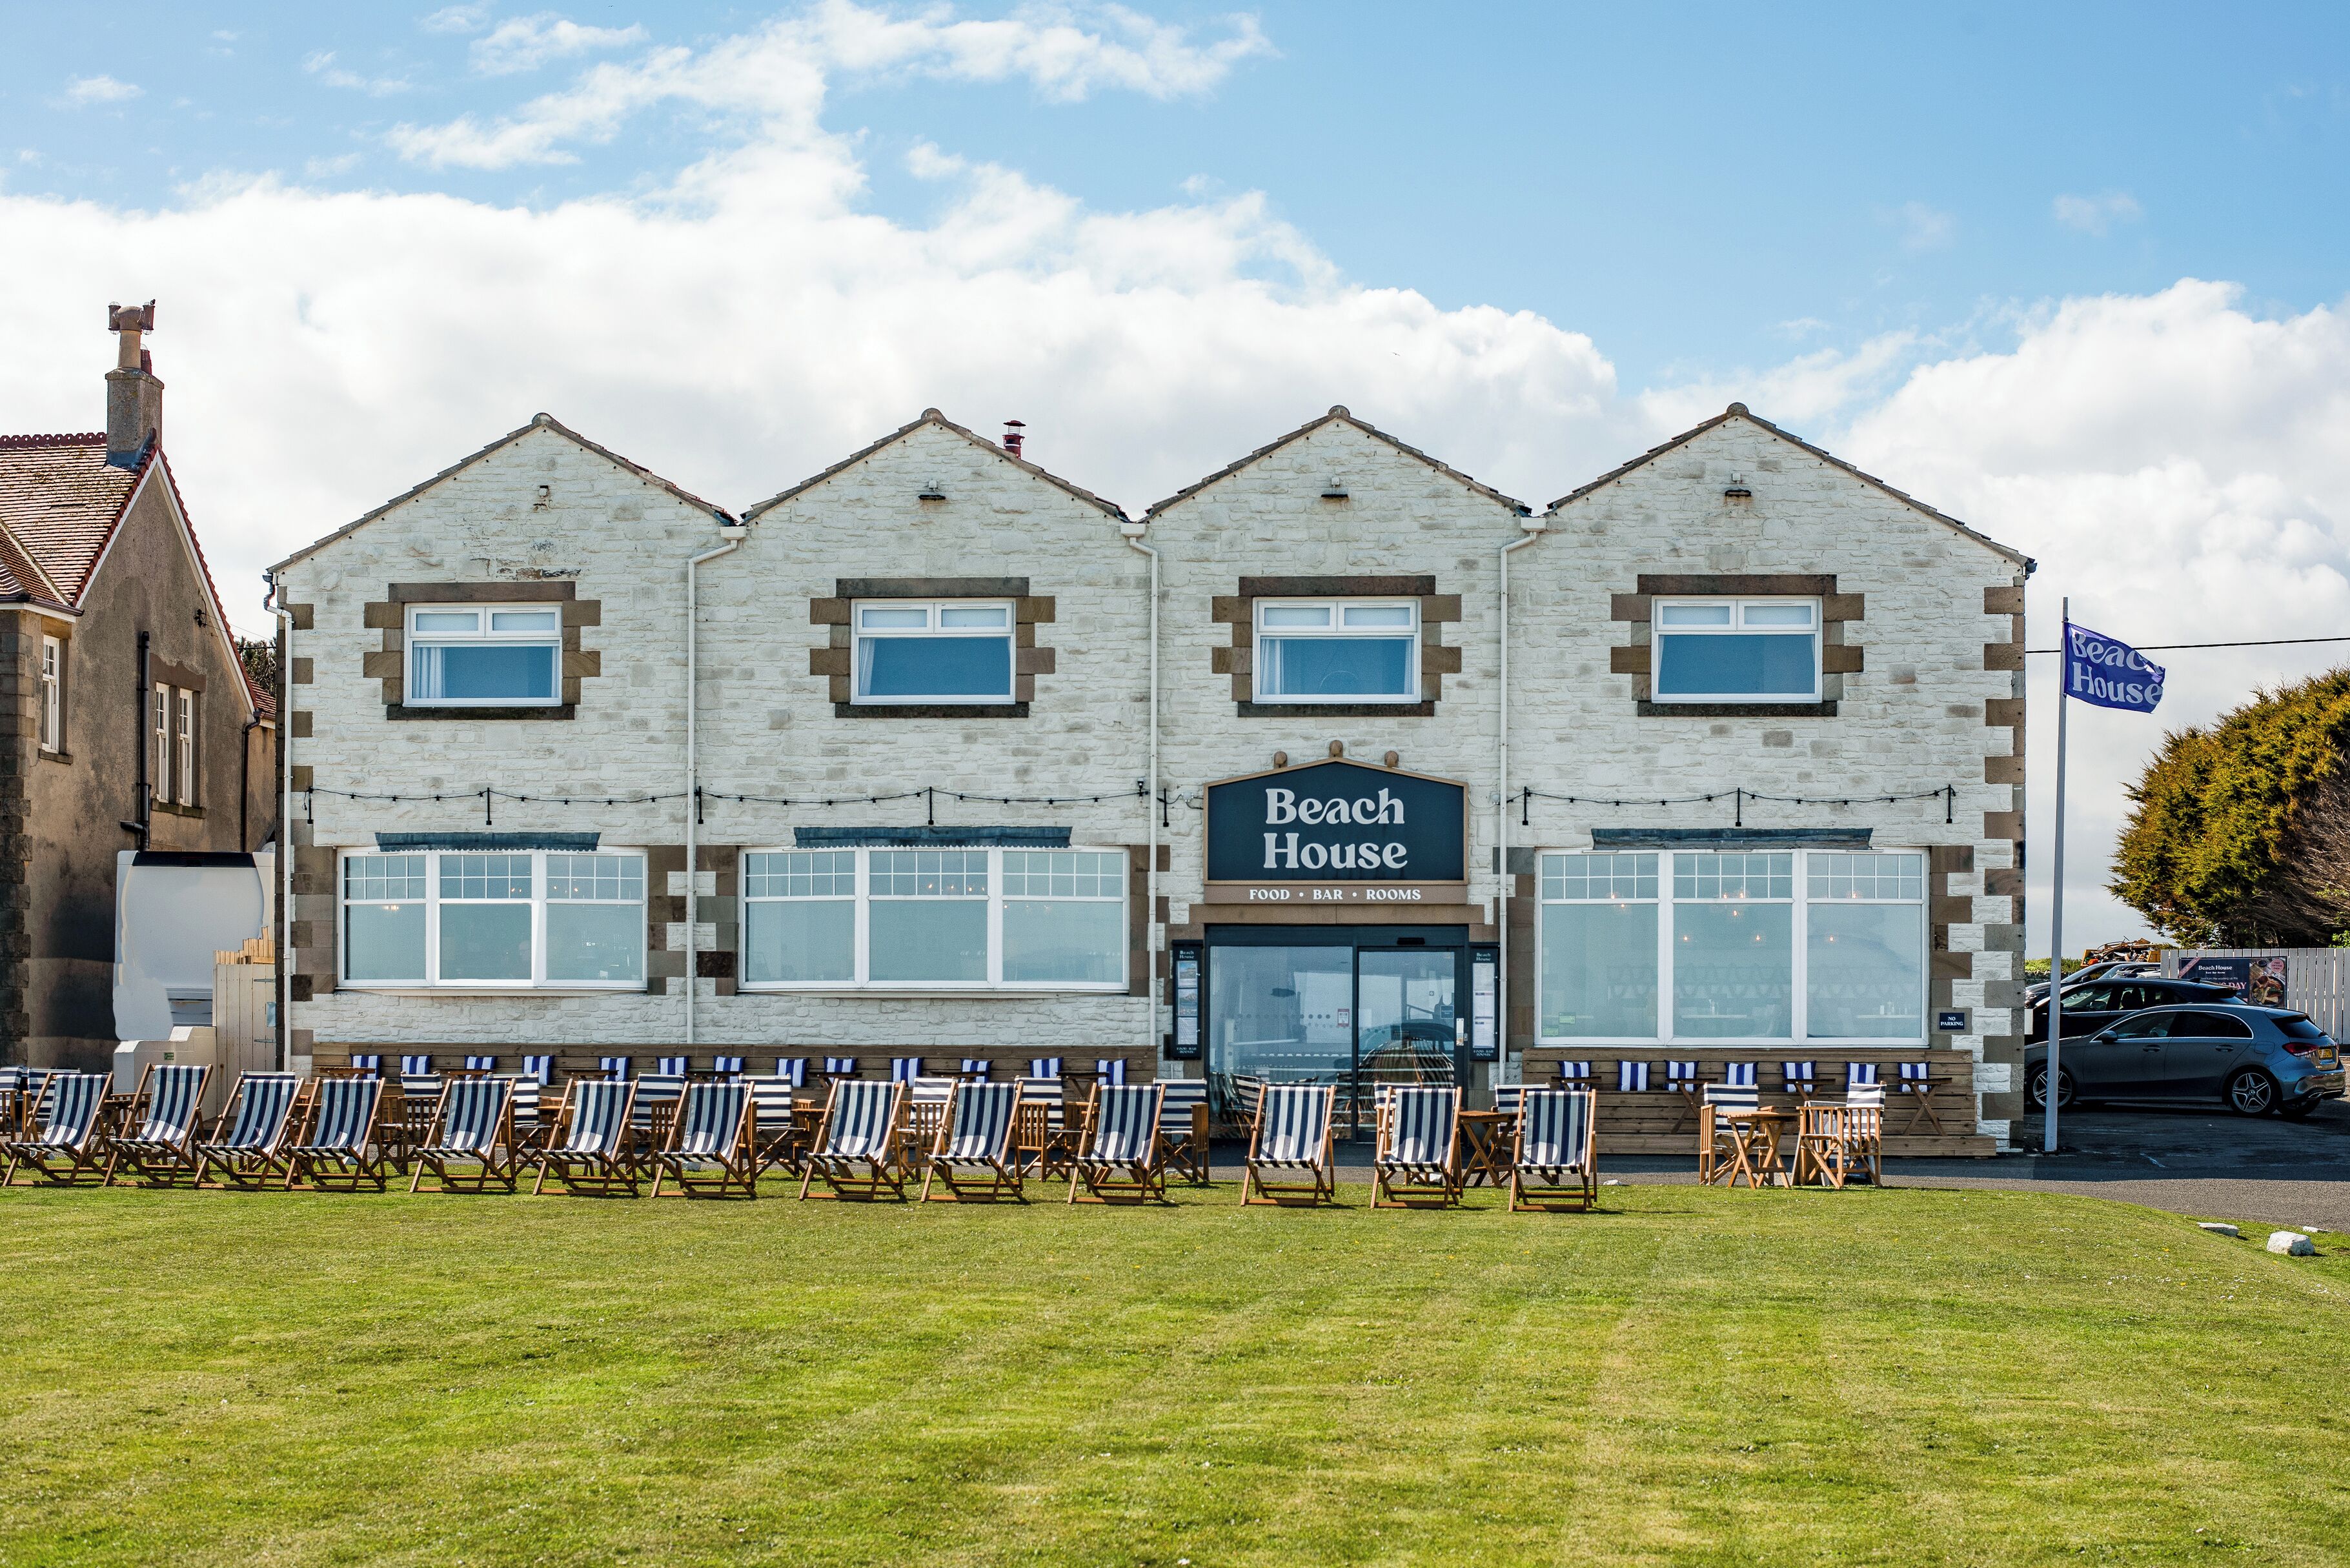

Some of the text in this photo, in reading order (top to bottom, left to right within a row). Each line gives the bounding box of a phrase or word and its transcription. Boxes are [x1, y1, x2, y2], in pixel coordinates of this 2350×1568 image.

[2071, 627, 2163, 674] Beac
[2072, 661, 2163, 705] House
[1265, 787, 1405, 825] Beach
[1263, 832, 1408, 869] House
[1249, 889, 1421, 900] FOOD BAR ROOMS
